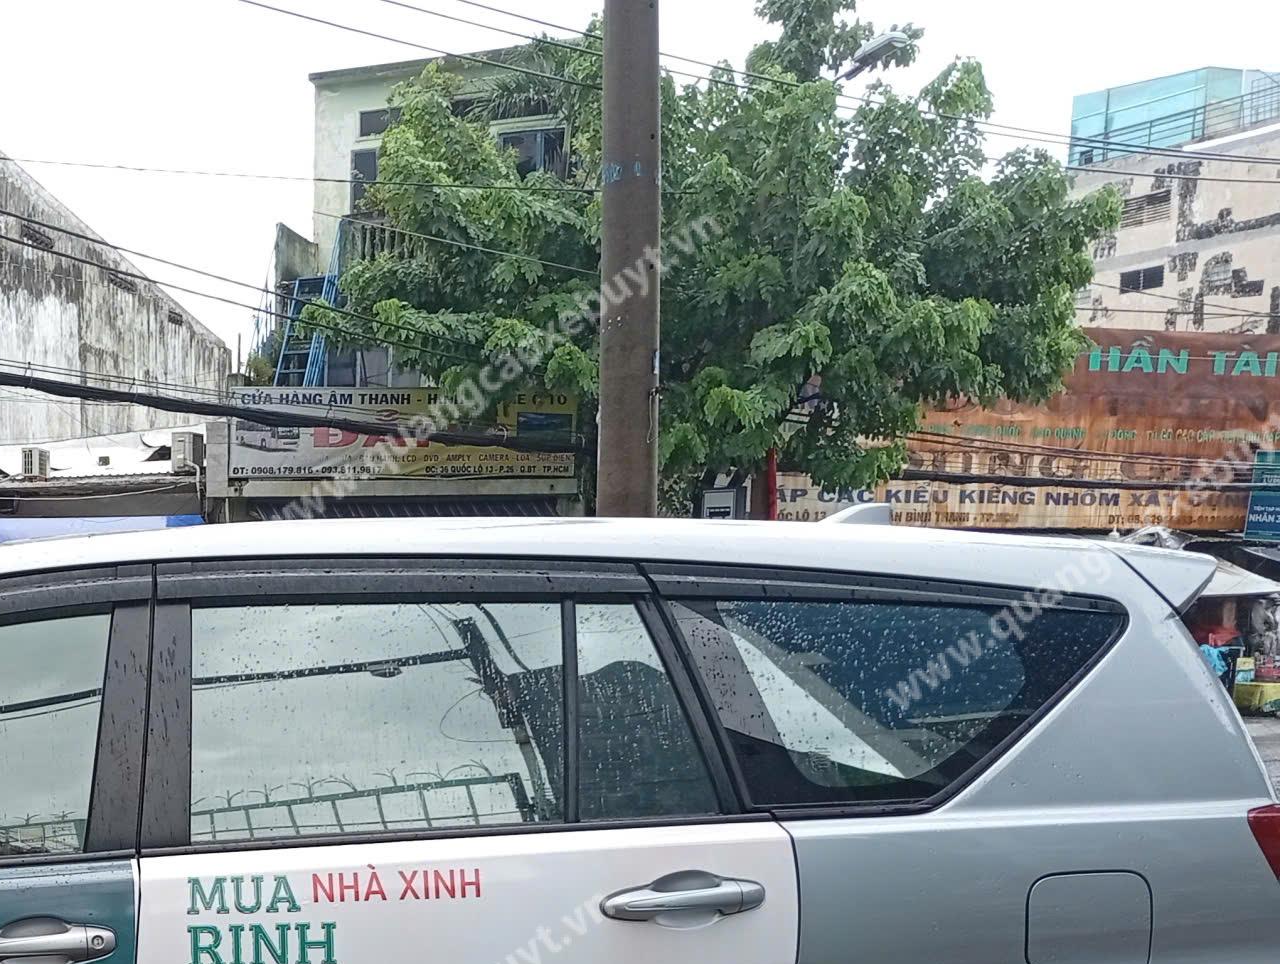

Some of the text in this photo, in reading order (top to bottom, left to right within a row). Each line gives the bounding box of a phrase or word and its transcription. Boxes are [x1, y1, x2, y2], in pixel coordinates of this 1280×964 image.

[1087, 335, 1280, 377] HẦN TÀI
[328, 390, 353, 405] ÂM
[358, 393, 411, 405] THANH
[1045, 488, 1119, 506] NHÔM
[187, 864, 481, 915] MUA NHÀ XINH
